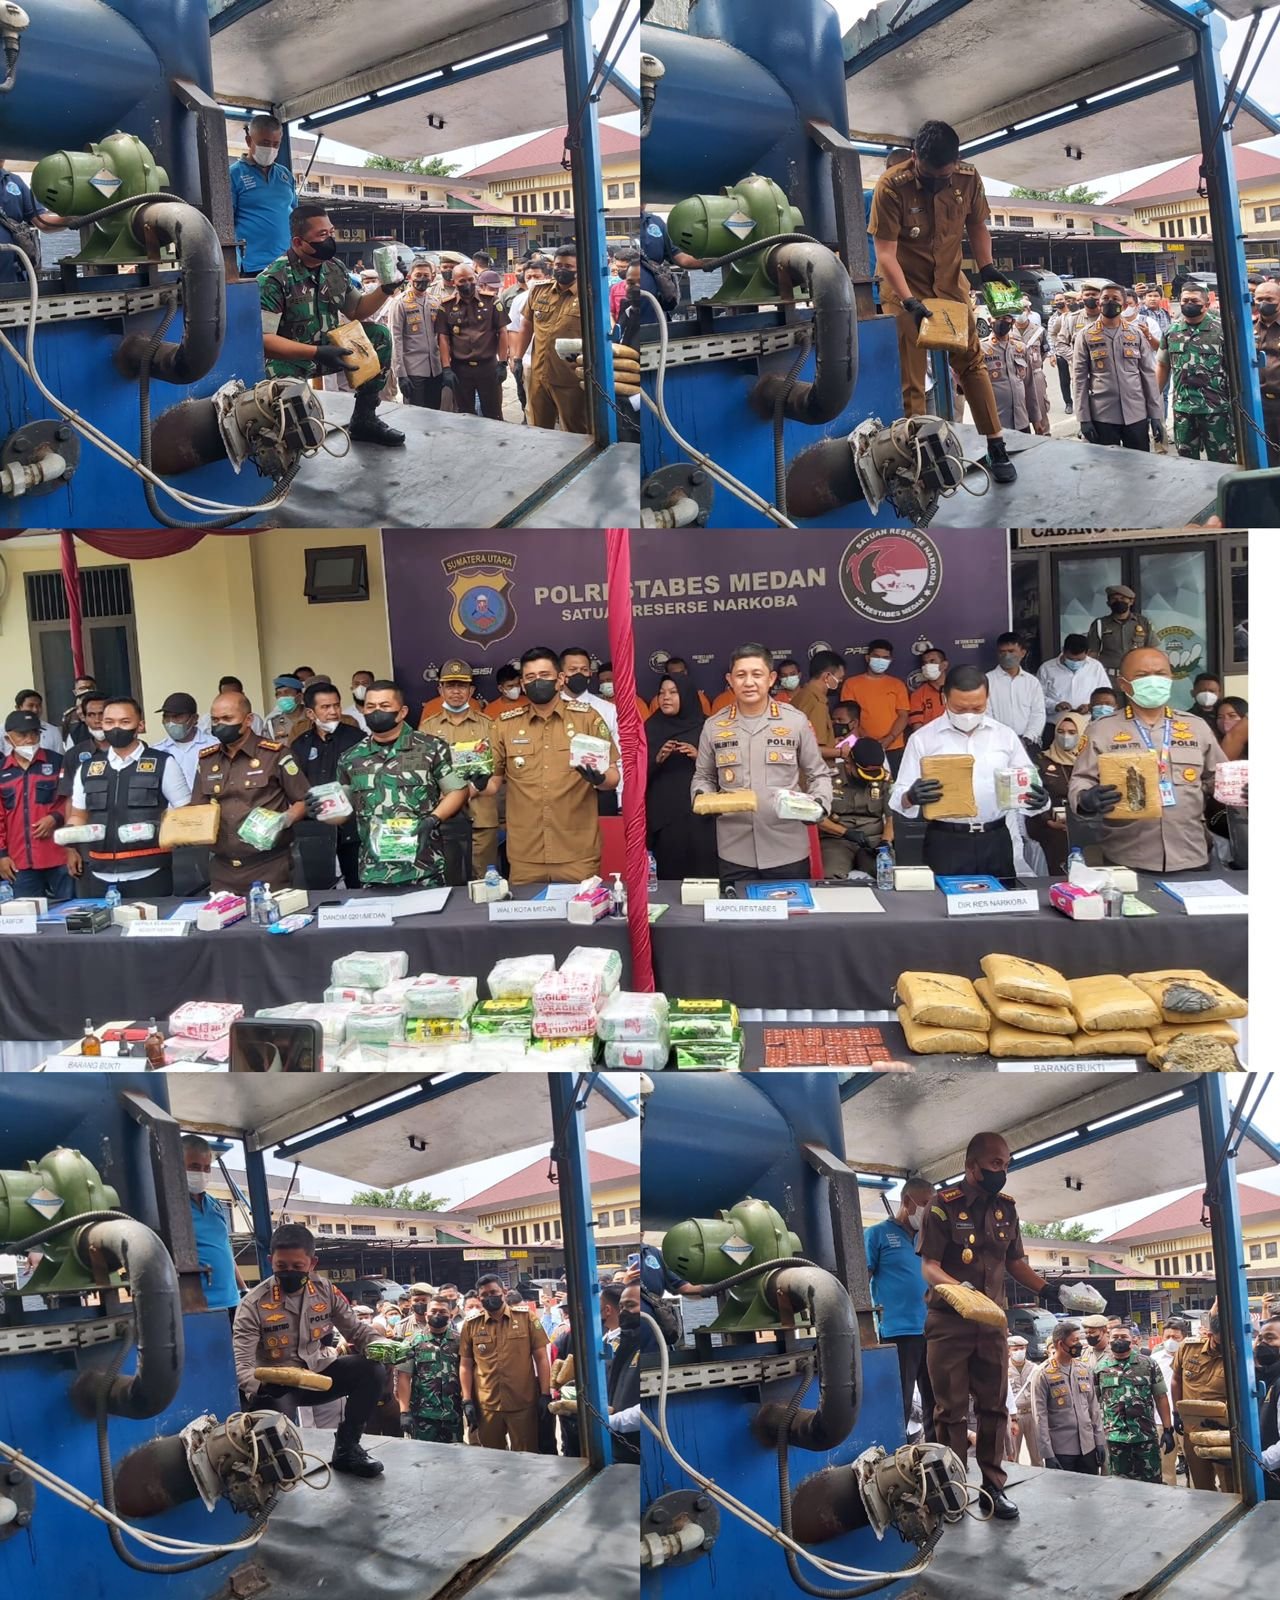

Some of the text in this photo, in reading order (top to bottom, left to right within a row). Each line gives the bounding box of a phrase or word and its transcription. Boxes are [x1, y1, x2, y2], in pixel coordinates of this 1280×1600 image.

[446, 554, 513, 570] SUMATERA UTARA
[855, 528, 937, 586] SATUAN RESERSE NARKOBA
[729, 567, 827, 593] MEDAN
[632, 600, 708, 617] RESERSE
[713, 594, 798, 612] NARKOBA
[853, 596, 926, 618] POLRESTABES MEDAN
[767, 738, 796, 747] POLRI
[1170, 740, 1199, 748] POLRI
[715, 905, 777, 913] KAPOLRESTABES
[1033, 1062, 1106, 1072] BARANG BUKTI
